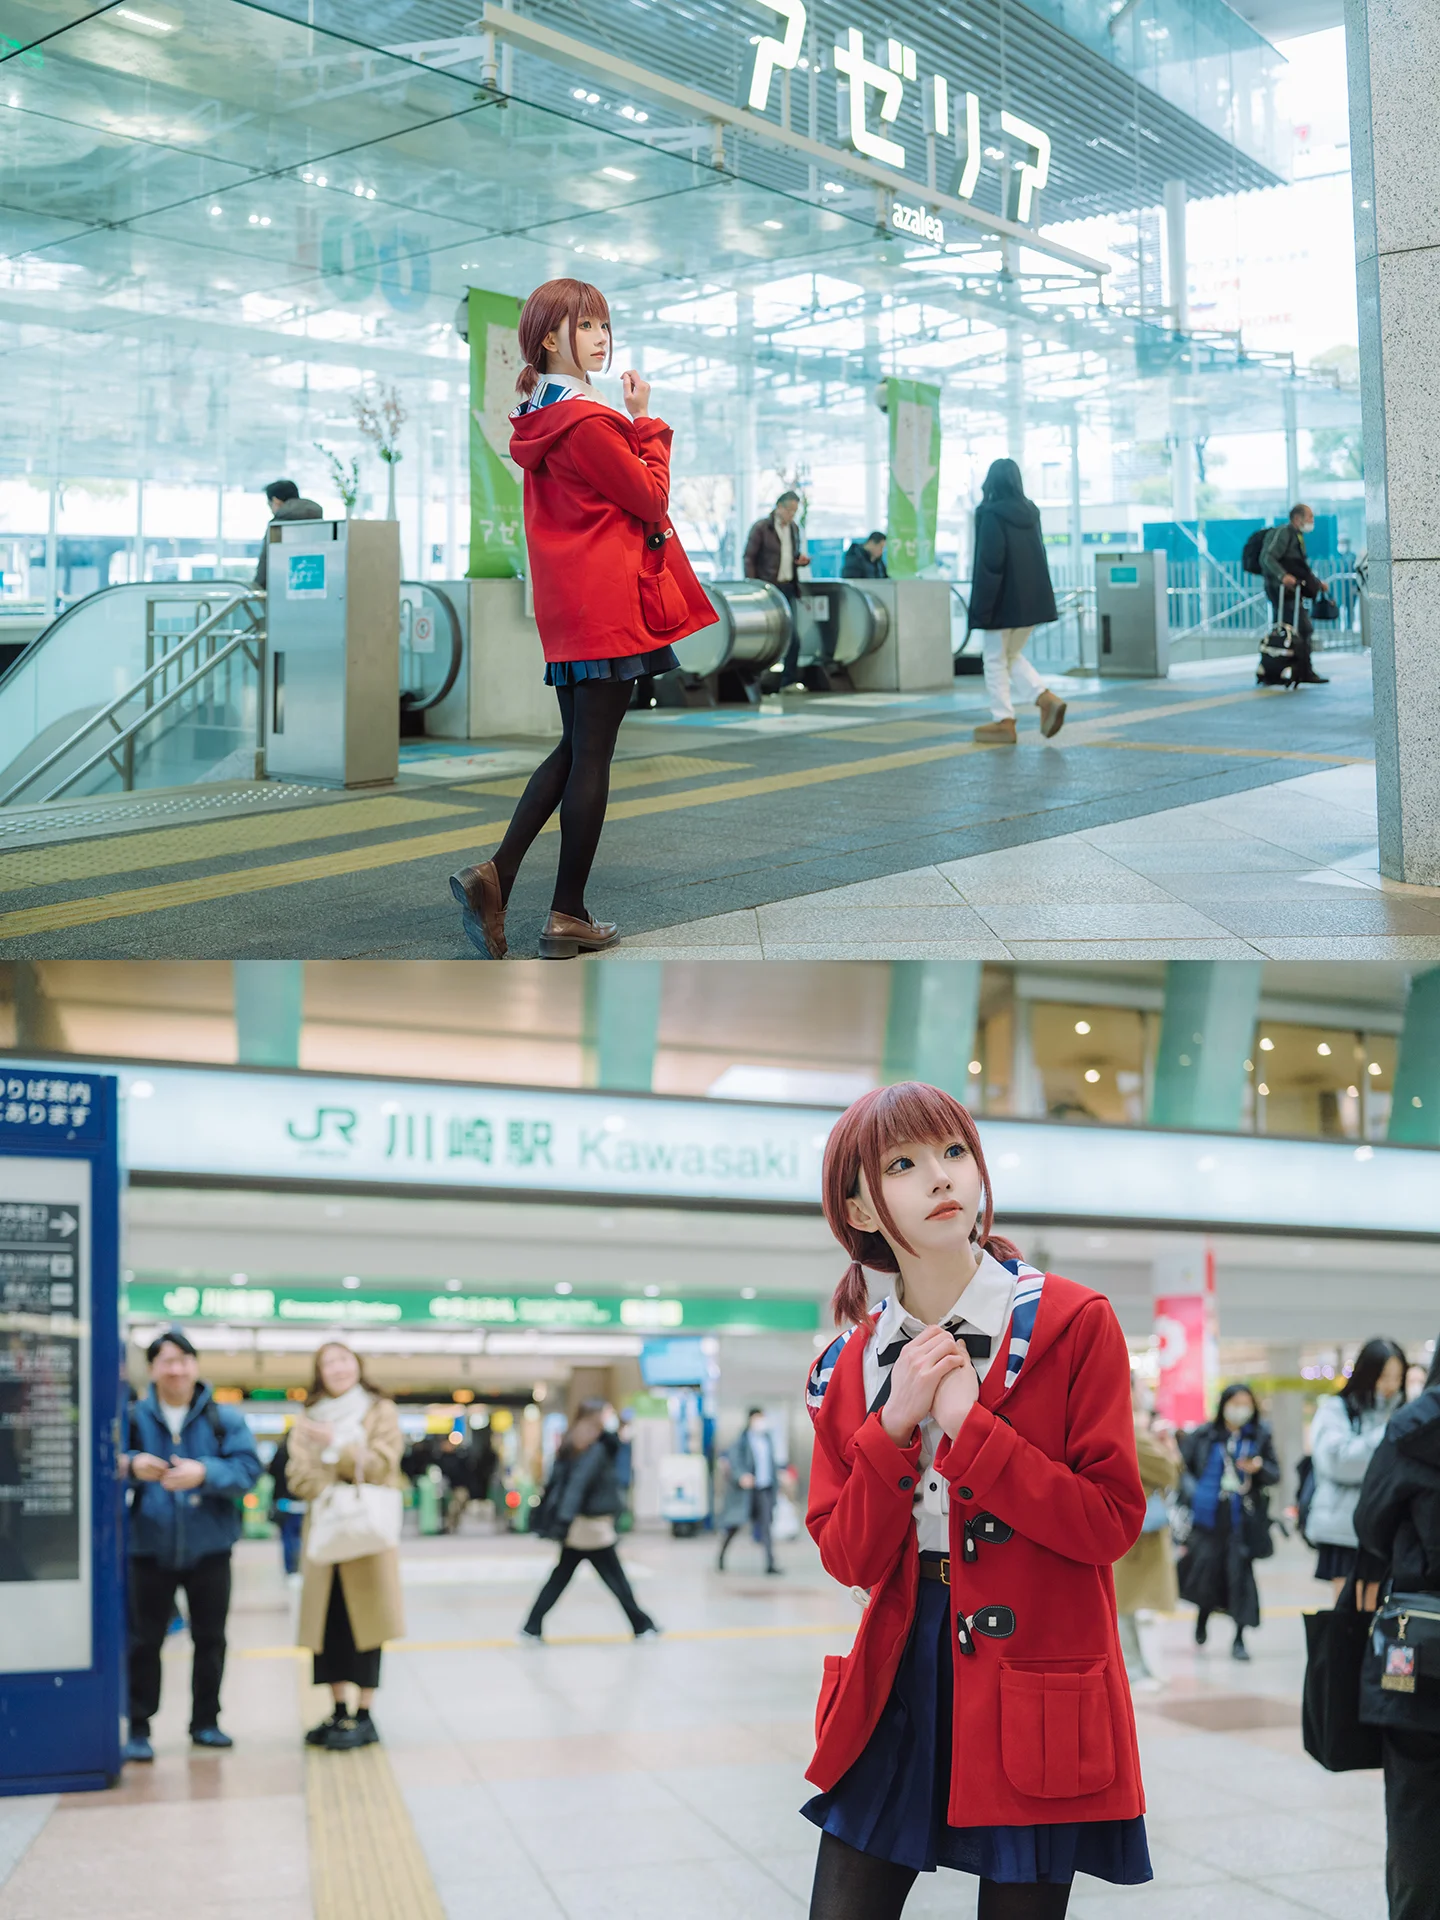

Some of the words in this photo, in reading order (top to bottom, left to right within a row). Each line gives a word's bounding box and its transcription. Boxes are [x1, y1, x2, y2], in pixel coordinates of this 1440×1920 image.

[747, 0, 1051, 223] アゼリア
[892, 202, 945, 244] azalea
[286, 1106, 356, 1145] JR
[385, 1112, 554, 1166] 川崎駅
[577, 1124, 799, 1180] Kawasaki
